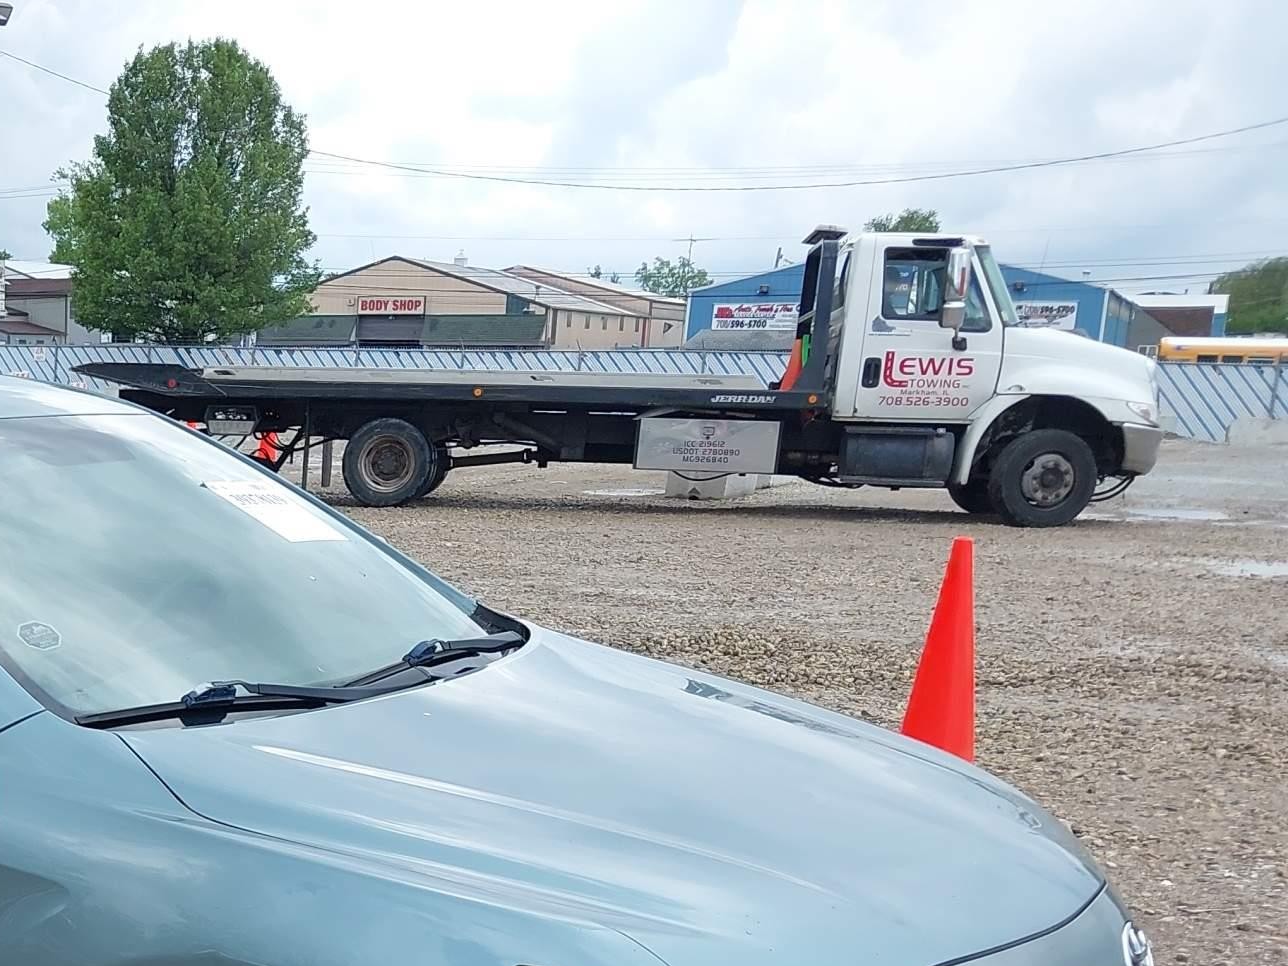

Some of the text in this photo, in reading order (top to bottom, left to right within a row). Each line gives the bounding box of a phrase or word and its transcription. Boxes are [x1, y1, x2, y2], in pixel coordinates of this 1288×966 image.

[360, 300, 421, 311] BODY SHOP
[883, 351, 975, 388] LEWIS
[909, 378, 961, 389] TOWING
[672, 447, 741, 456] USDOT 2780890
